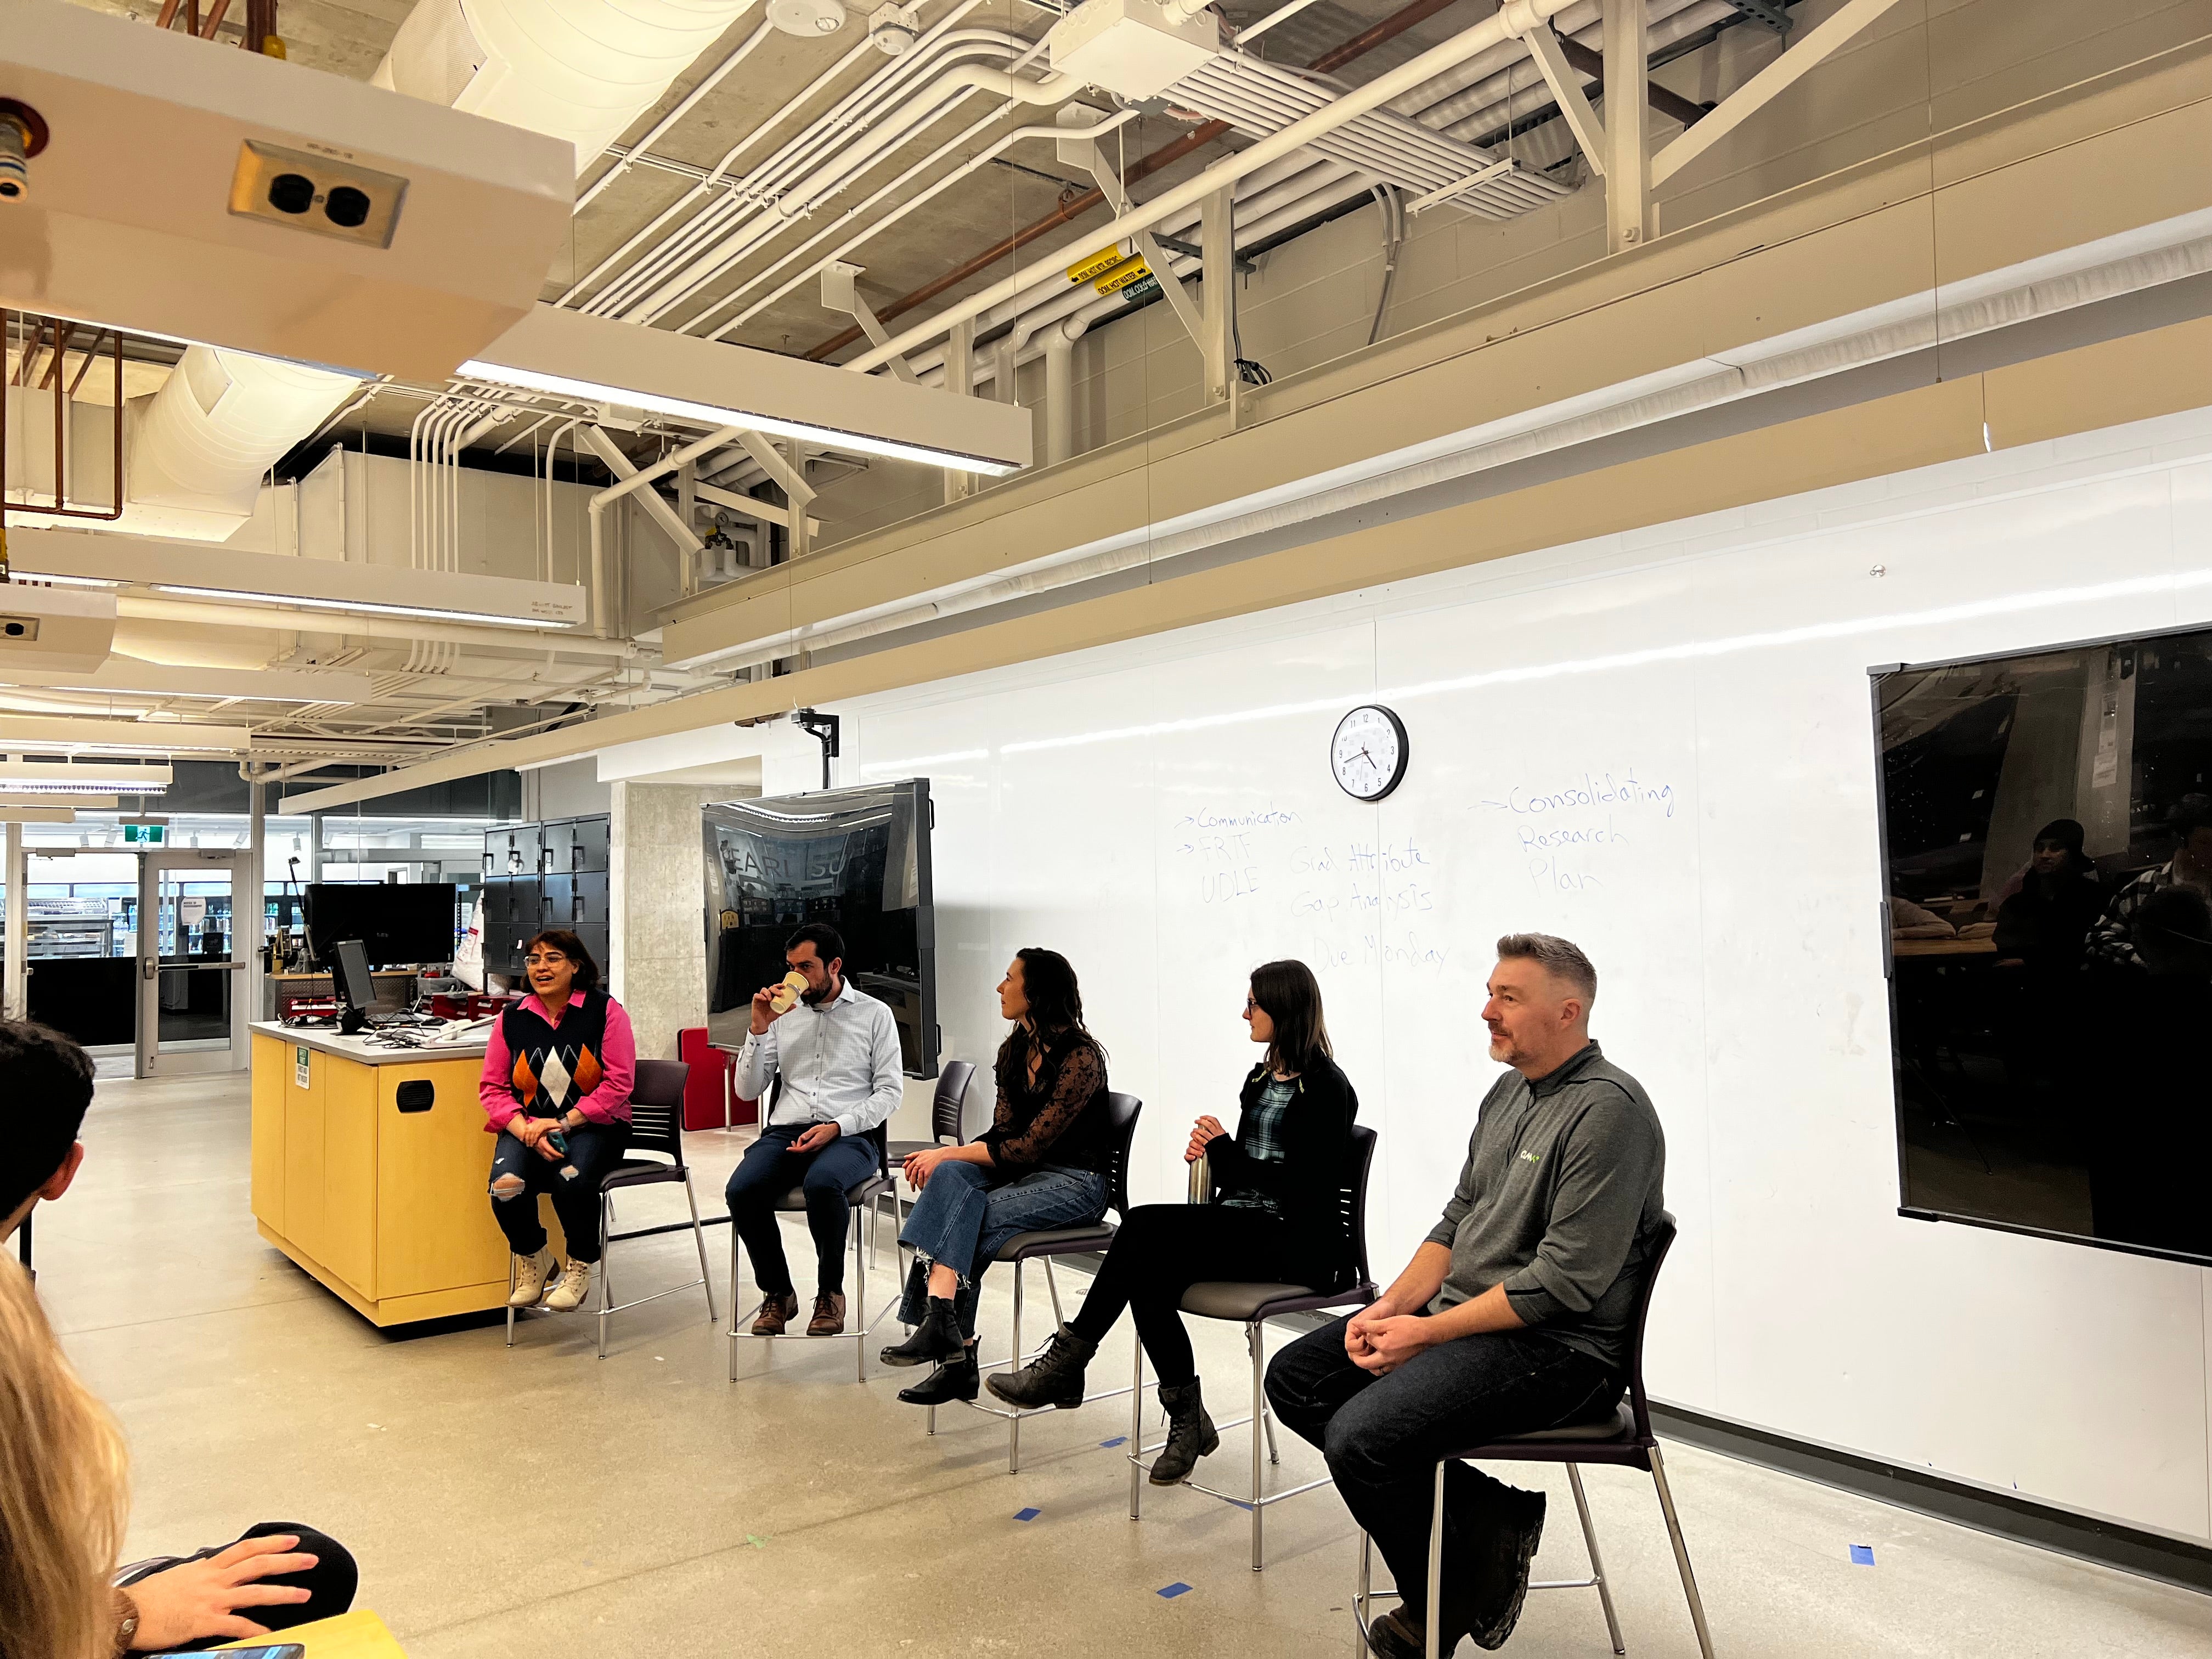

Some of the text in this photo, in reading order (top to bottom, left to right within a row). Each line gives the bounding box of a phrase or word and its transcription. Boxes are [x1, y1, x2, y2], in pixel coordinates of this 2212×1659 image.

[1109, 278, 1120, 289] HOT
[1119, 272, 1138, 283] WATER
[1134, 280, 1148, 294] COLD
[1351, 720, 1356, 728] 11
[1363, 714, 1368, 723] 12
[1339, 750, 1342, 758] 9
[1391, 746, 1394, 754] 3
[1342, 767, 1346, 775] 8
[1387, 764, 1391, 772] 4
[1352, 779, 1355, 788] 7
[1364, 783, 1368, 792] 6
[1378, 778, 1381, 786] 5
[1510, 767, 1674, 817] Consolidating
[1198, 800, 1304, 828] Communication
[1517, 814, 1629, 853] Research
[1290, 837, 1430, 873] Grad Attribute
[1528, 856, 1604, 898] Plan
[1202, 867, 1260, 903] UDLE
[1291, 878, 1432, 922] Gap Analysis
[1314, 932, 1450, 979] Due Monday
